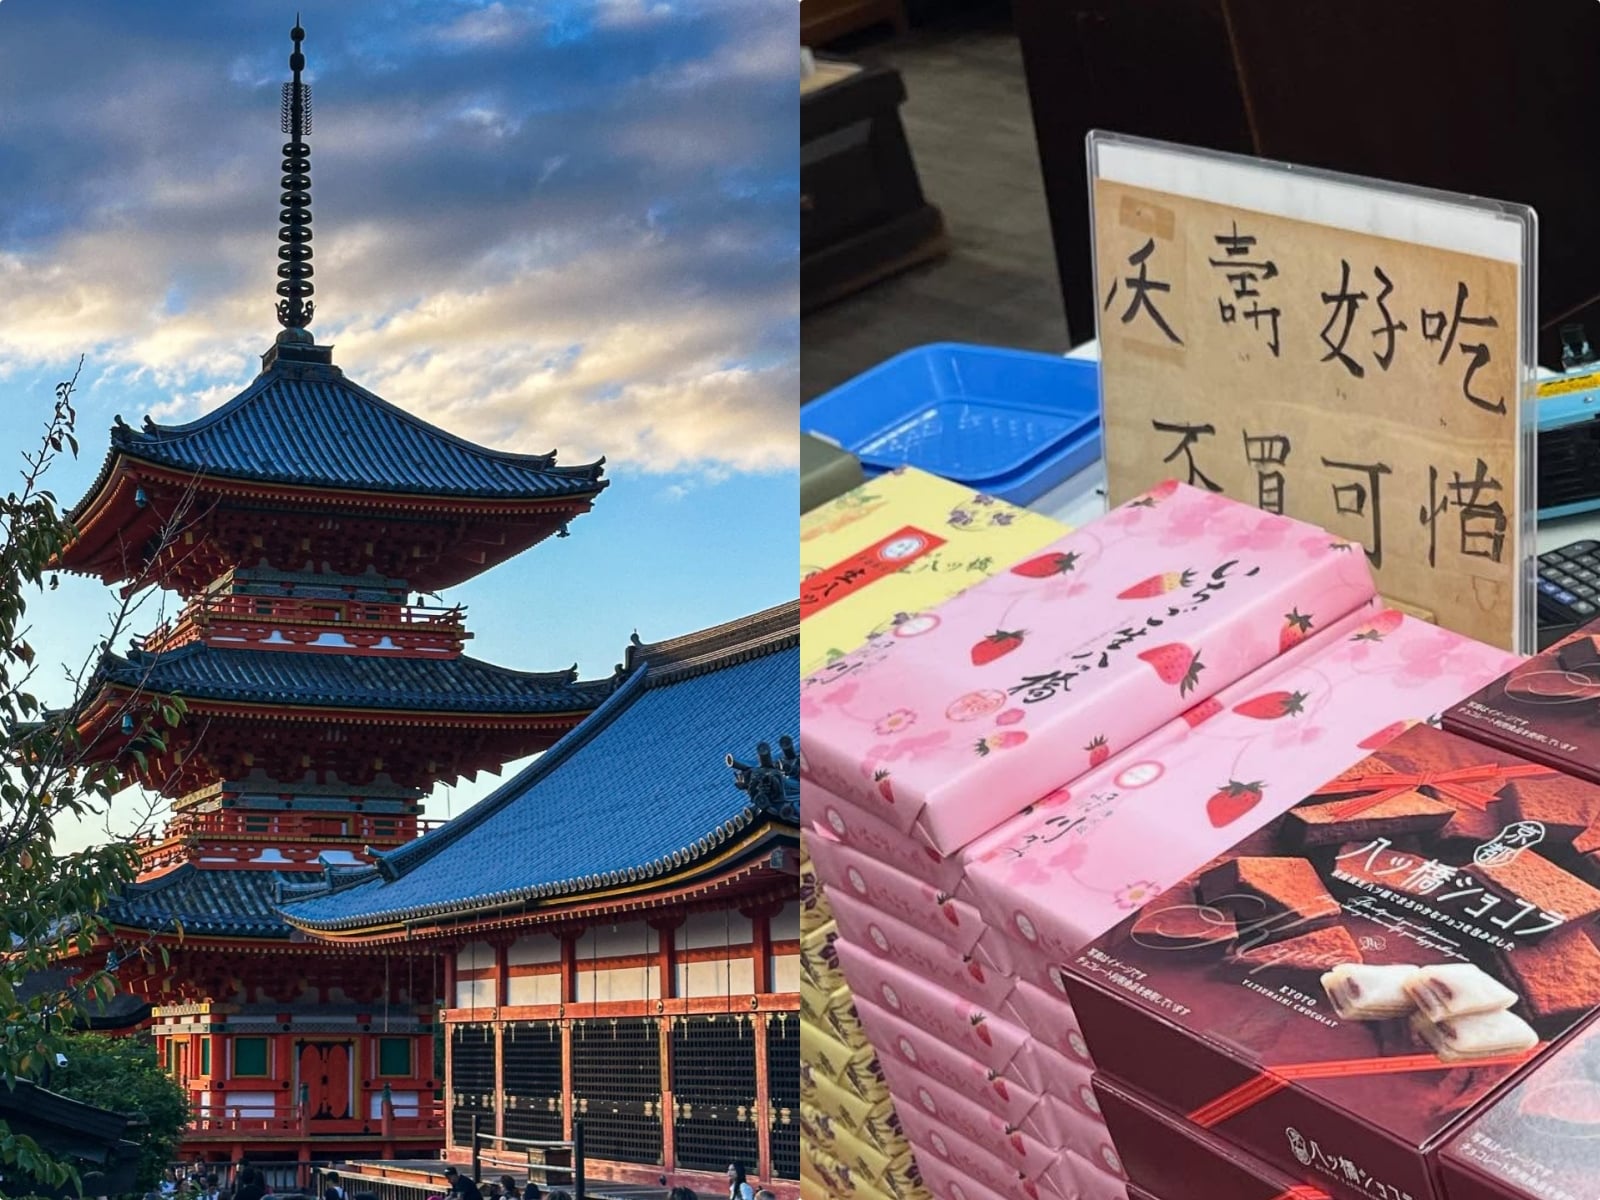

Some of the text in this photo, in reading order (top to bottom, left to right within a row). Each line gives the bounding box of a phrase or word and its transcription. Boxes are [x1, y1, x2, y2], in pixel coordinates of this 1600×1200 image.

[1478, 822, 1542, 865] 京都
[1279, 985, 1317, 1007] KYOTO
[1292, 1004, 1339, 1028] CHOCOLAT
